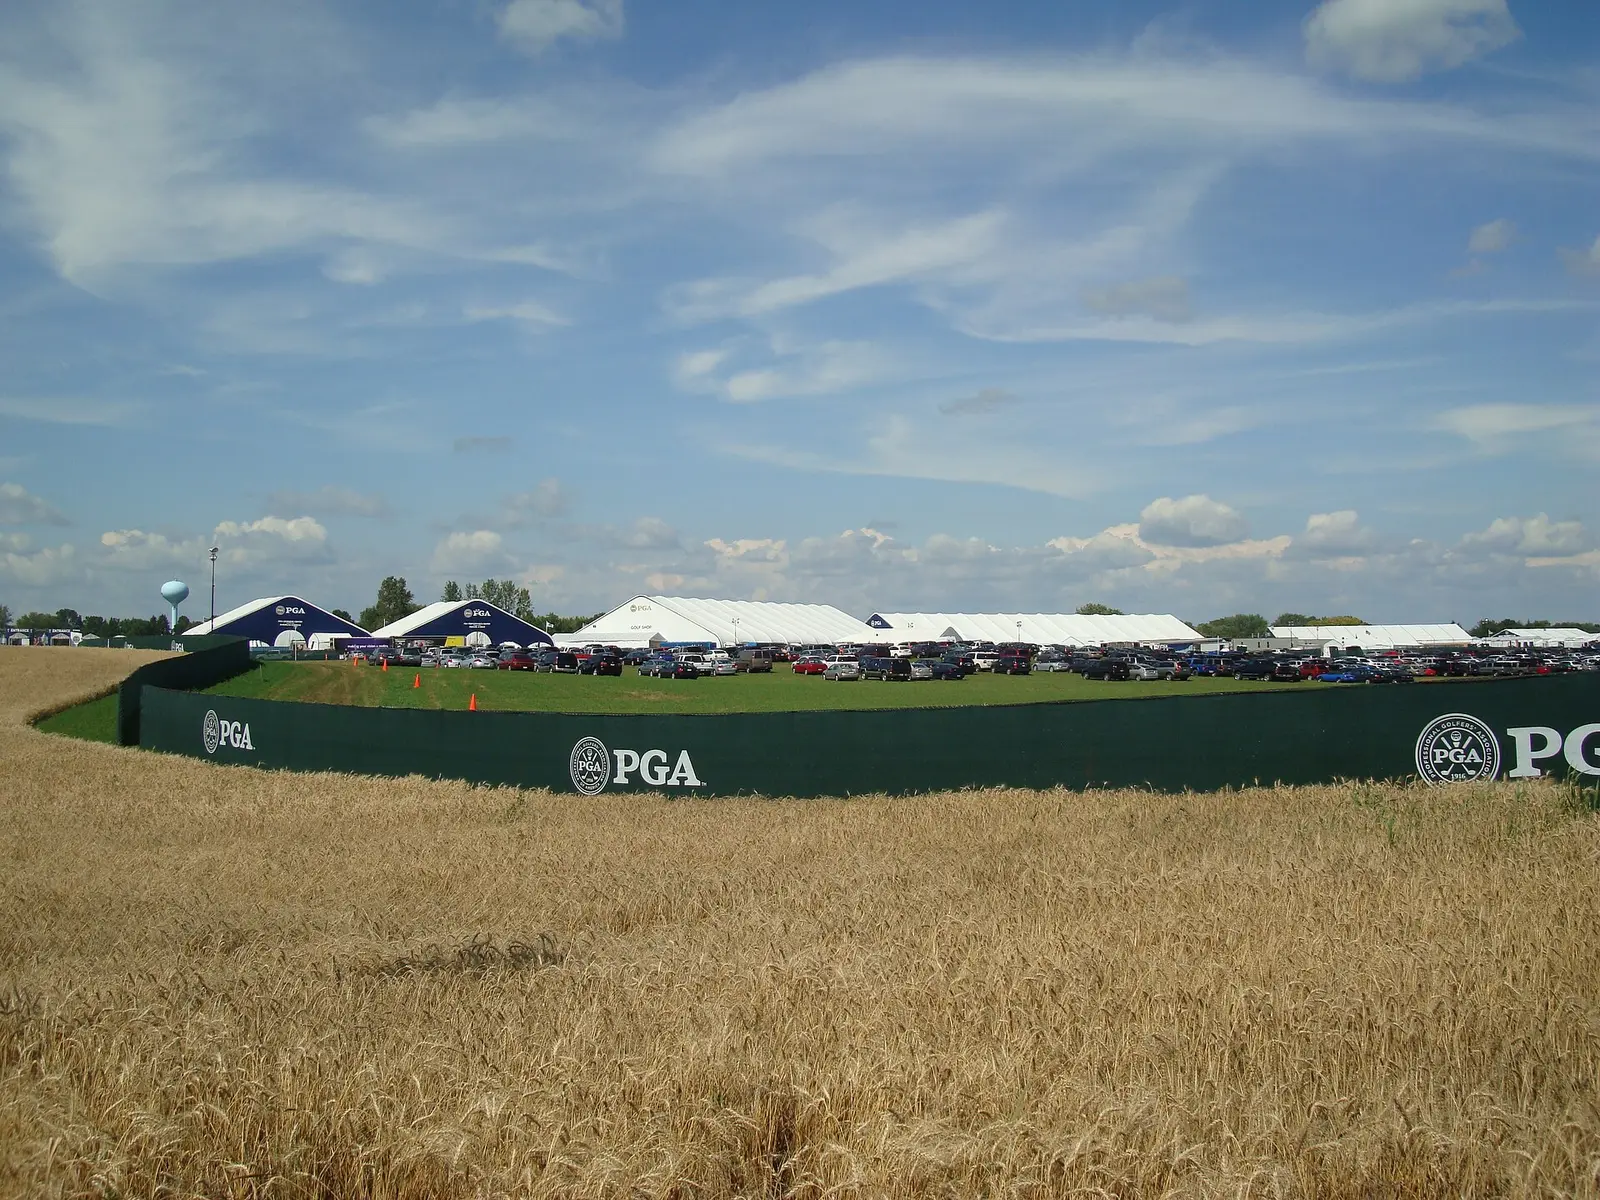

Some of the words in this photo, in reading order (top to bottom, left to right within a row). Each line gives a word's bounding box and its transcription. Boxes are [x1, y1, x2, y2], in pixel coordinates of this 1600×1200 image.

[219, 720, 253, 750] PGA
[1507, 723, 1600, 777] PG
[579, 761, 601, 771] PGA
[613, 750, 701, 786] PGA
[1422, 727, 1441, 779] PROFESSIONAL
[1476, 730, 1492, 778] ASSOCIATION
[1432, 748, 1483, 764] PGA
